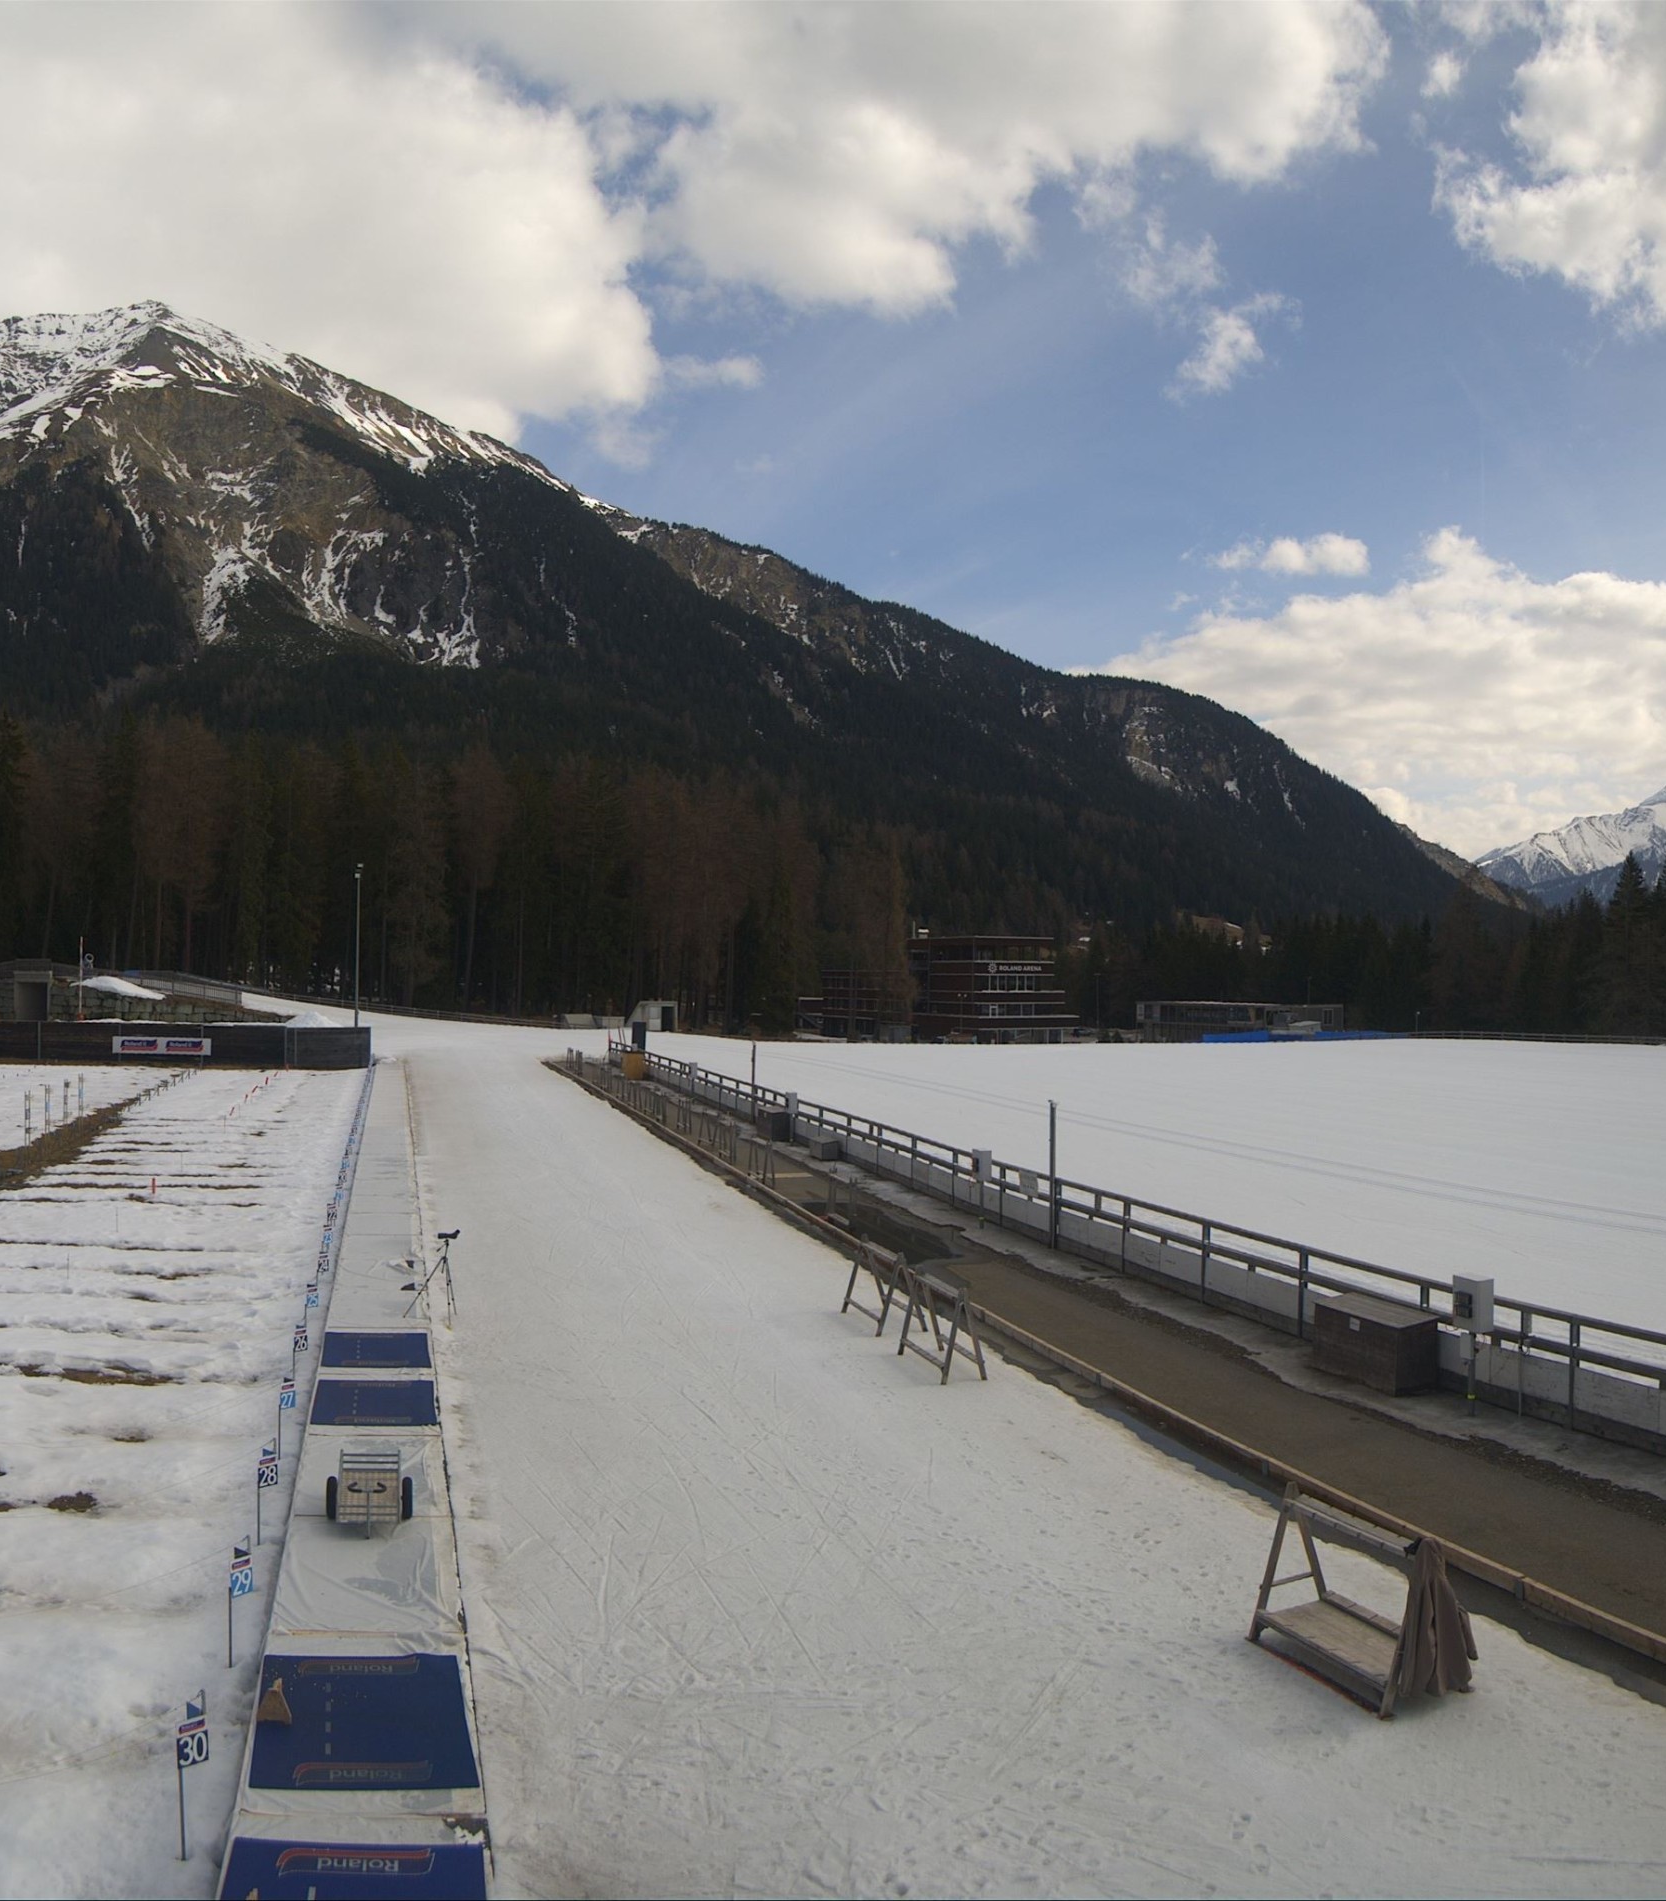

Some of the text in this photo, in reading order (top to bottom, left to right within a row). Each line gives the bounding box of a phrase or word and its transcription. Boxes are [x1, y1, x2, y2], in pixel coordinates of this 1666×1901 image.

[308, 1294, 318, 1307] 25
[295, 1336, 307, 1351] 26
[280, 1392, 294, 1409] 27
[259, 1465, 277, 1487] 28
[232, 1570, 252, 1597] 29
[330, 1662, 393, 1673] Roland
[178, 1731, 208, 1766] 30
[329, 1769, 402, 1781] Roland
[317, 1856, 399, 1872] Roland
